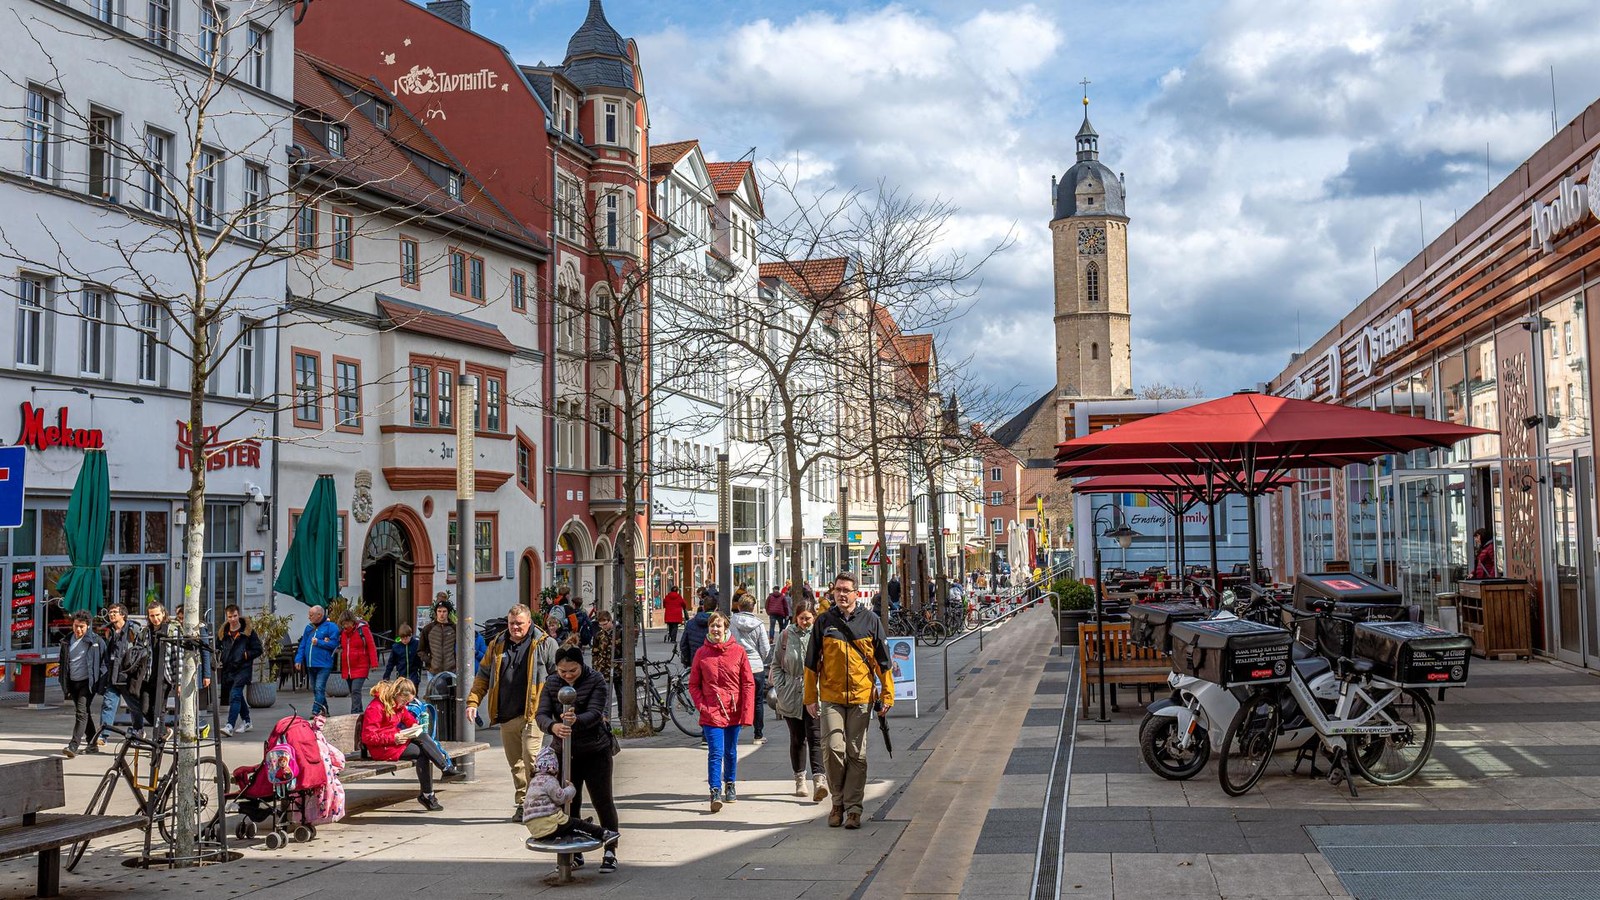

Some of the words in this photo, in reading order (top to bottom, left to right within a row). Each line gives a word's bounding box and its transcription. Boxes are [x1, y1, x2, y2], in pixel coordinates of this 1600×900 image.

[1531, 176, 1588, 254] Apollo
[14, 401, 104, 451] Mekan
[1131, 513, 1172, 527] Ernsting's
